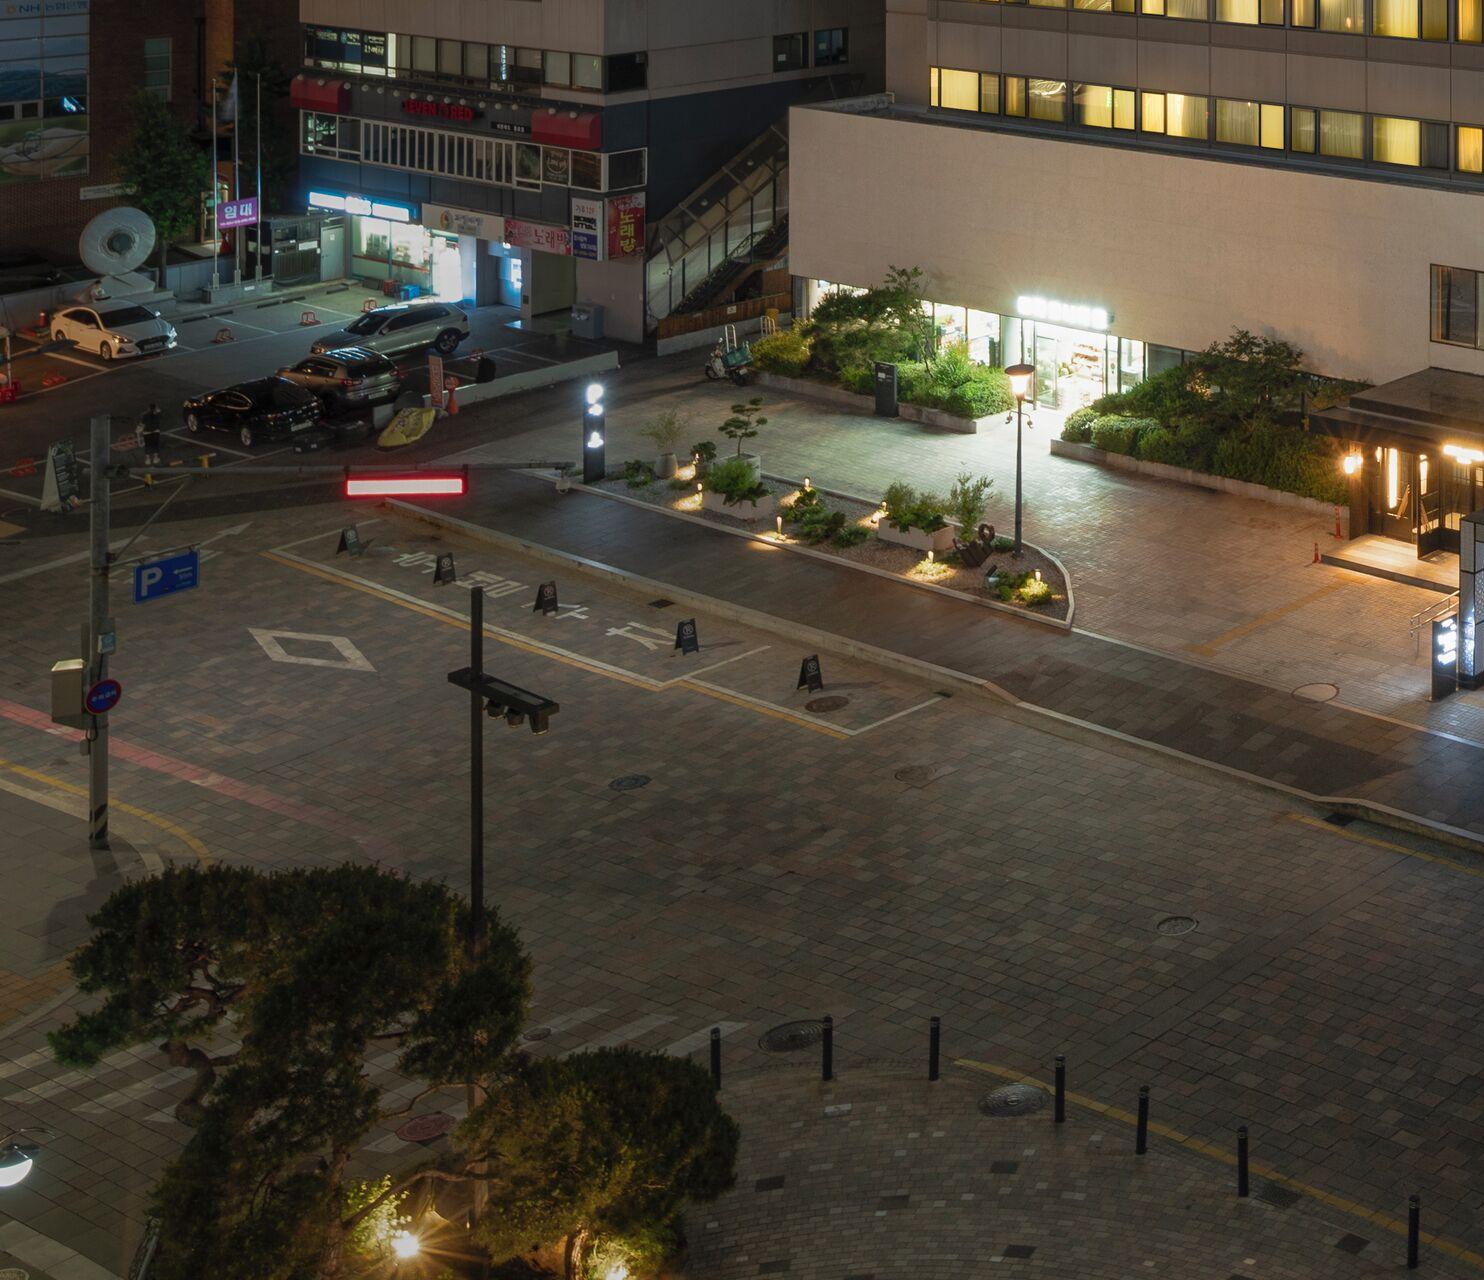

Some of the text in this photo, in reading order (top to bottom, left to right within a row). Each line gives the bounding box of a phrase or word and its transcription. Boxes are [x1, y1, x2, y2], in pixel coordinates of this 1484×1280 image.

[224, 202, 252, 220] 임대
[619, 211, 637, 254] 노래방
[141, 566, 163, 597] P
